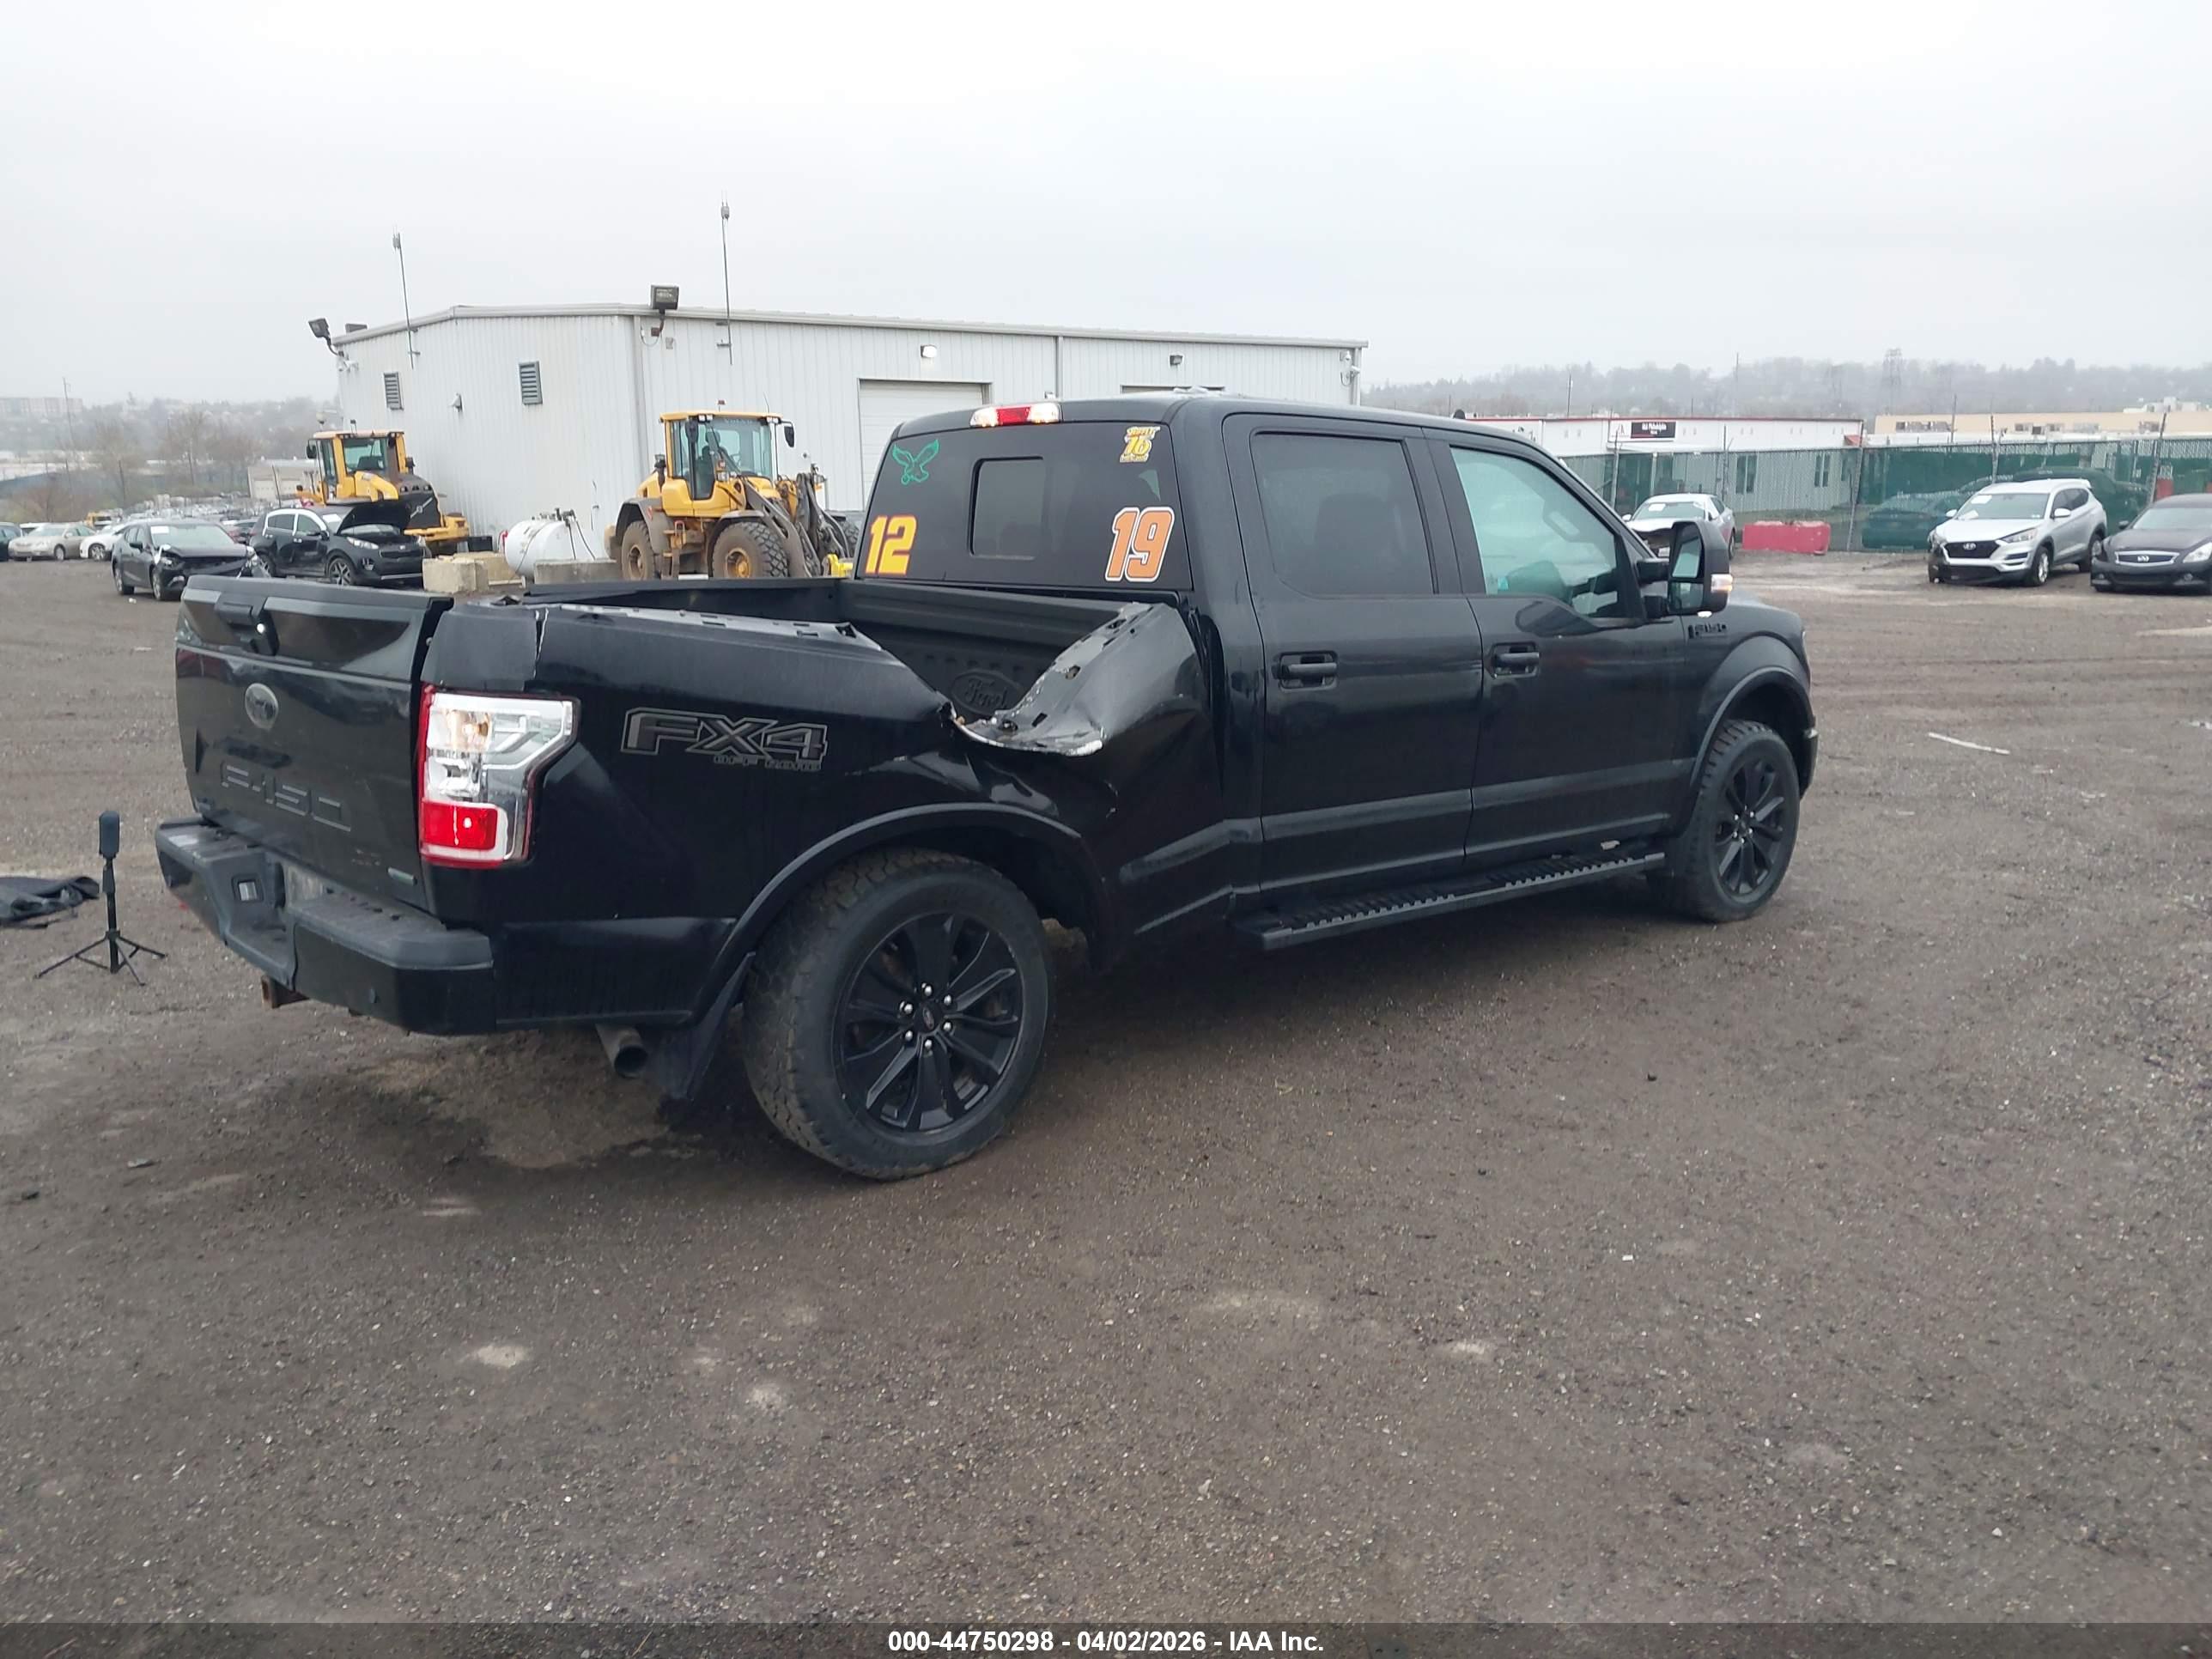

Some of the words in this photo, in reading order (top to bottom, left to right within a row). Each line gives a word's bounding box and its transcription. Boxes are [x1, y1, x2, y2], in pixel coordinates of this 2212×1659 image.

[865, 514, 918, 575] 12
[1104, 506, 1176, 582] 19
[621, 707, 829, 764] FX4
[220, 760, 352, 831] F-150
